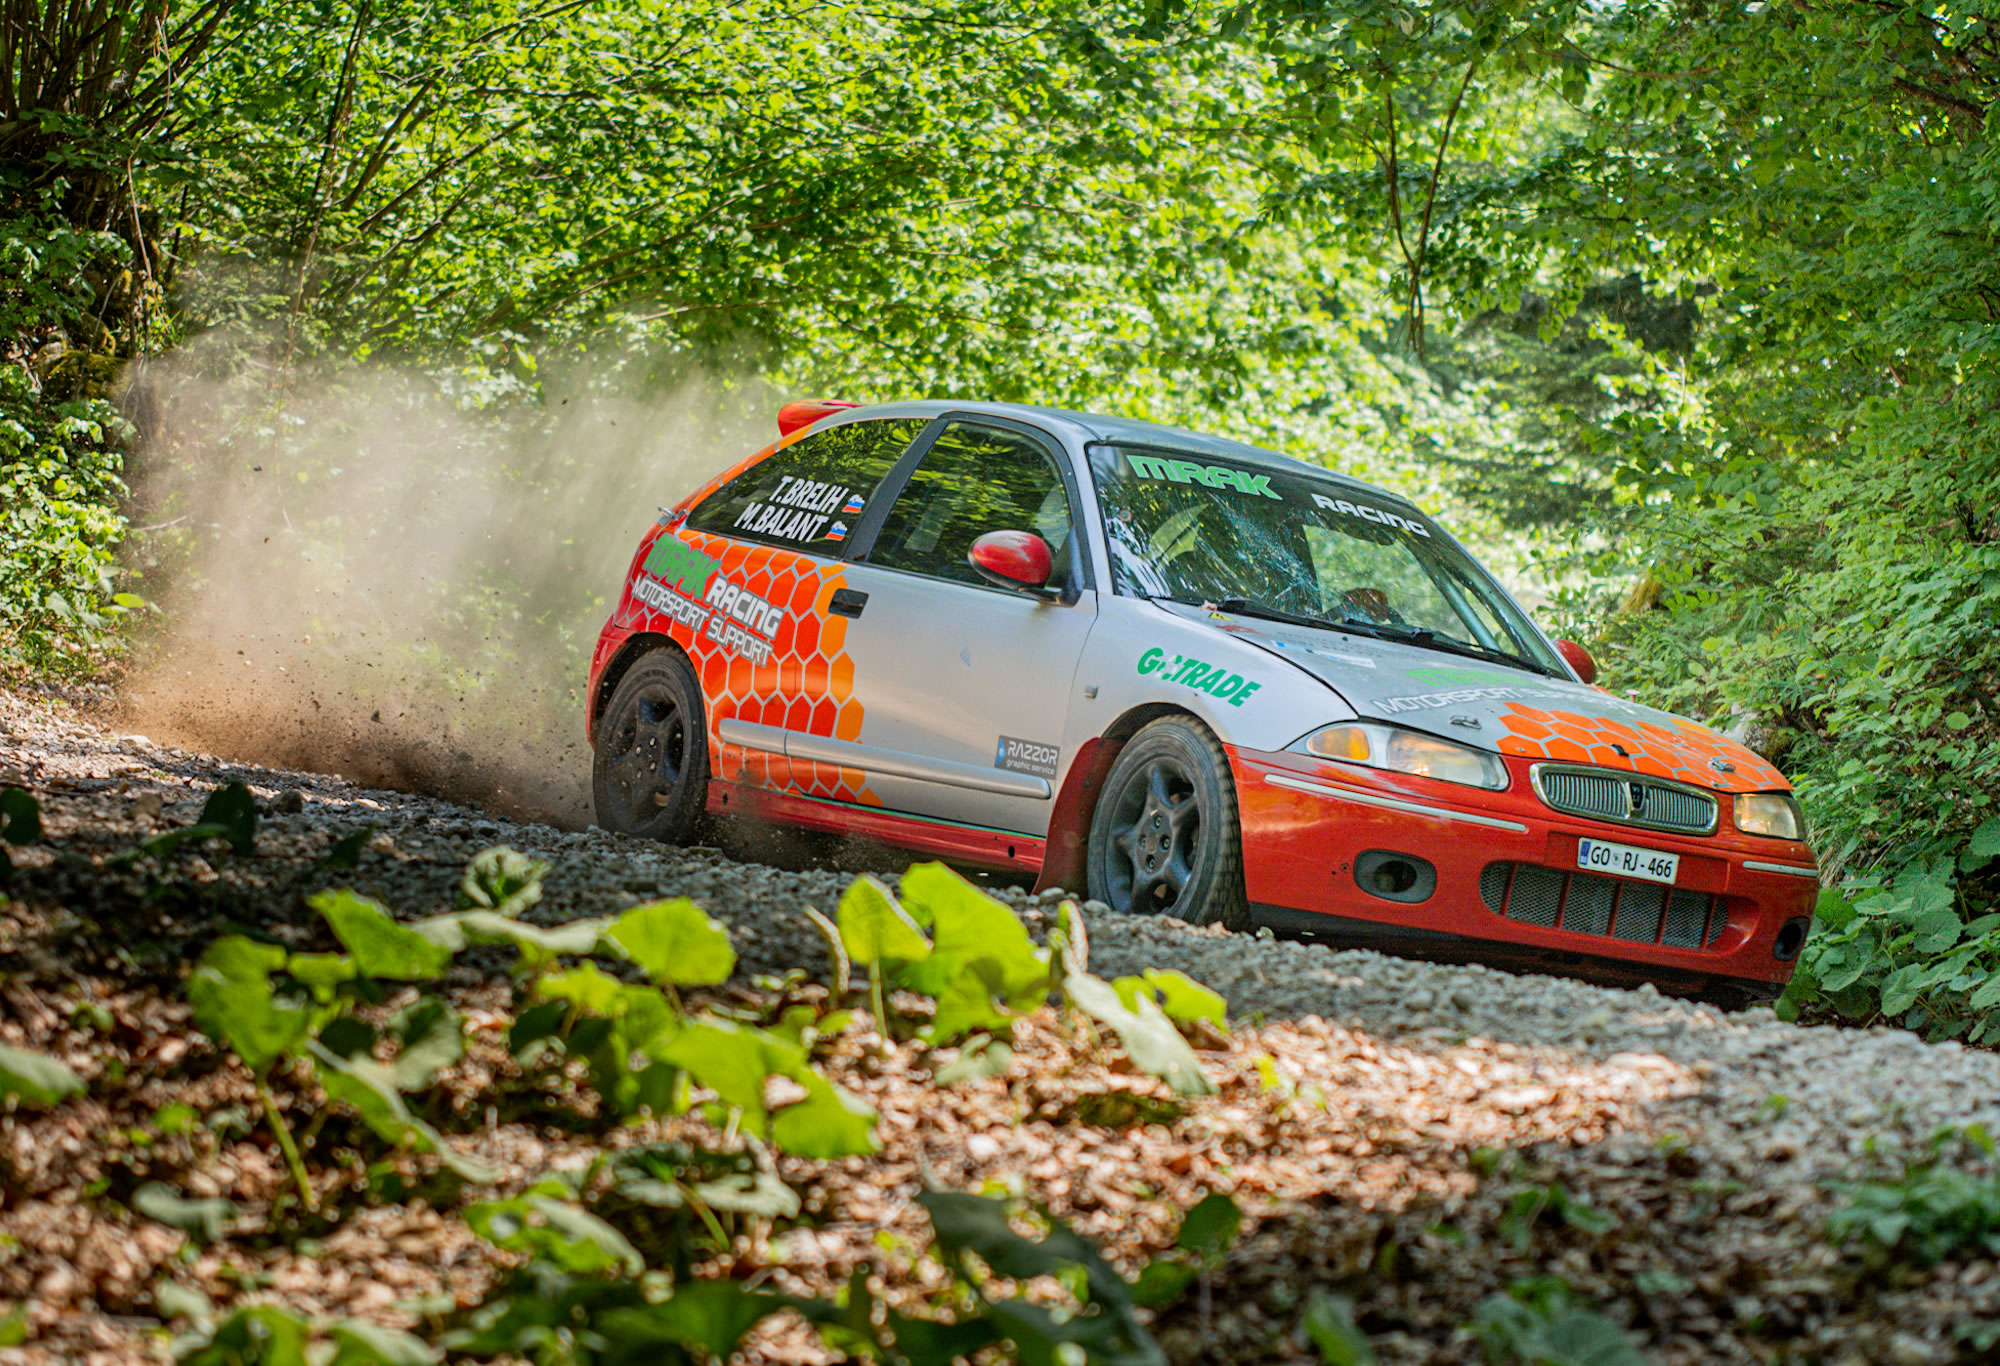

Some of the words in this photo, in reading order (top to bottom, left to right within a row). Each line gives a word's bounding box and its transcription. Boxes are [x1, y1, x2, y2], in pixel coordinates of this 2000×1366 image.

[769, 475, 849, 514] T.BRELIH
[1127, 455, 1283, 500] MRAK
[1311, 493, 1431, 538] RACING
[733, 501, 830, 543] M.BALANT
[642, 532, 722, 600] MRAK
[705, 576, 784, 640] RACING
[632, 573, 710, 632] MOTORSPORT
[706, 615, 773, 668] SUPPORT
[1006, 759, 1031, 771] graphic
[1031, 764, 1056, 776] service
[1591, 846, 1611, 866] GO
